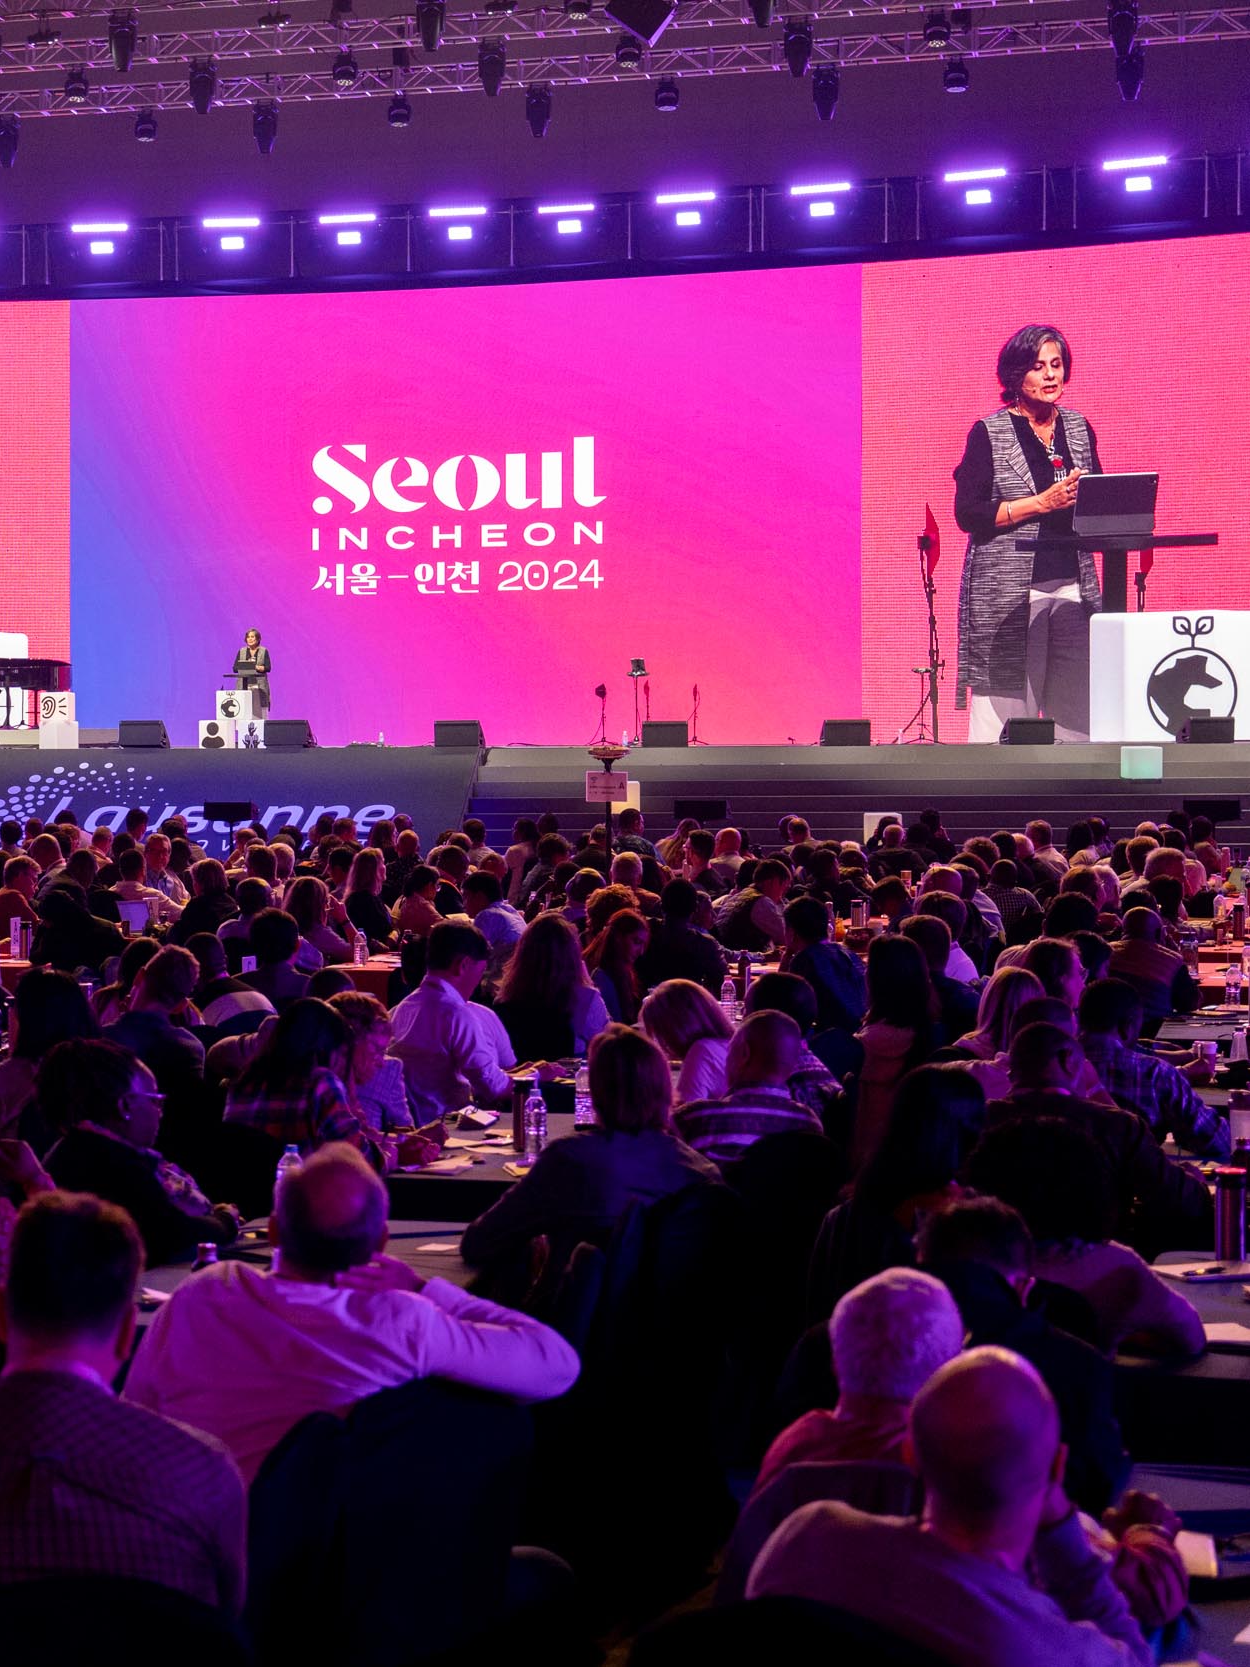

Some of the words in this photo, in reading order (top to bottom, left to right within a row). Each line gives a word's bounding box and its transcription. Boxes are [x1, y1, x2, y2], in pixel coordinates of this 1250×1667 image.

[312, 436, 607, 515] Seoul
[312, 521, 604, 551] INCHEON
[497, 559, 605, 592] 2024
